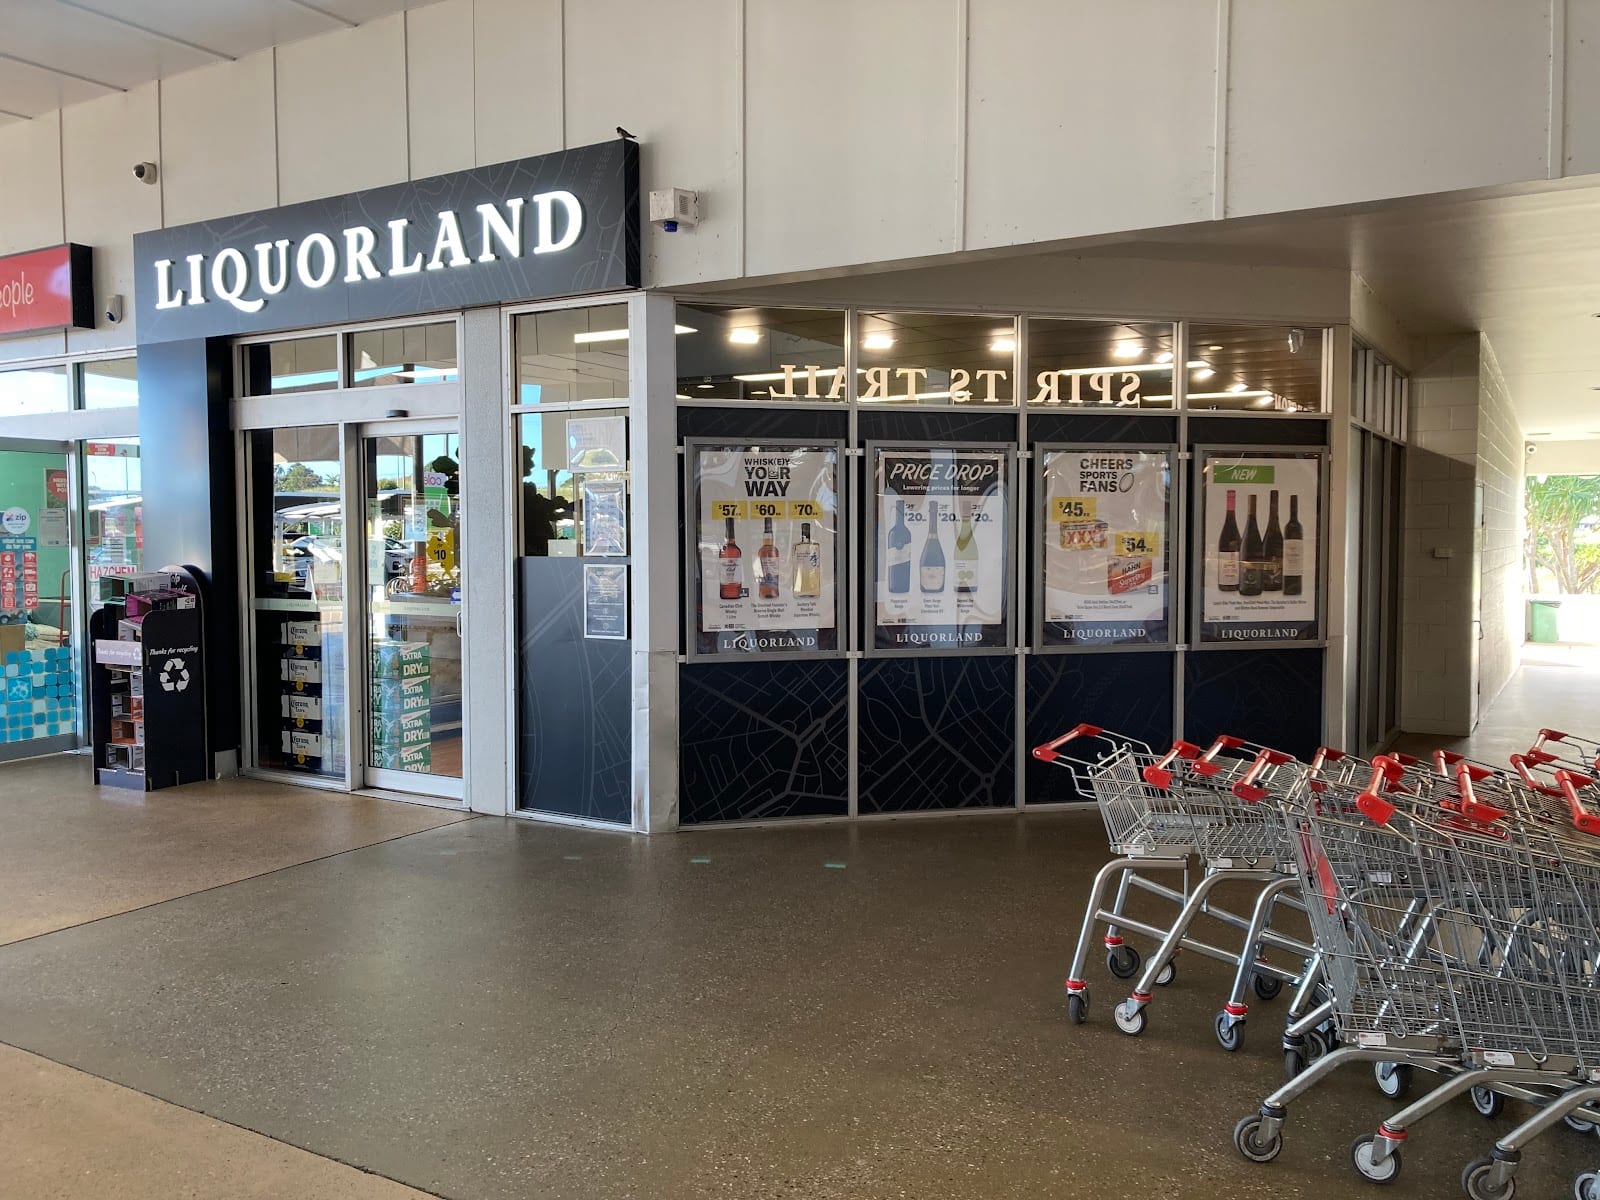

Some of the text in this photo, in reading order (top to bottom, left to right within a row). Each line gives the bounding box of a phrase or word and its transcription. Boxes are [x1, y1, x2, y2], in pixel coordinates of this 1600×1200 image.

[154, 189, 584, 314] LIQUORLAND
[1080, 458, 1133, 470] CHEERS
[890, 463, 994, 481] PRICE DROP
[1080, 471, 1117, 479] SPORTS
[1231, 469, 1257, 480] NEW
[744, 481, 790, 497] WAY
[903, 484, 930, 492] Lowering
[1080, 481, 1118, 493] FANS
[896, 632, 983, 645] LIQUORLAND
[1063, 628, 1146, 640] LIQUORLAND
[1221, 628, 1298, 640] LIQUORLAND
[723, 636, 816, 650] LIQUORLAND
[177, 645, 198, 655] recycling
[402, 652, 422, 661] EXTRA
[403, 663, 422, 676] DRY
[403, 685, 424, 695] EXTRA
[404, 696, 424, 710] DRY
[402, 719, 423, 730] EXTRA
[403, 729, 423, 743] DRY
[403, 752, 424, 763] EXTRA
